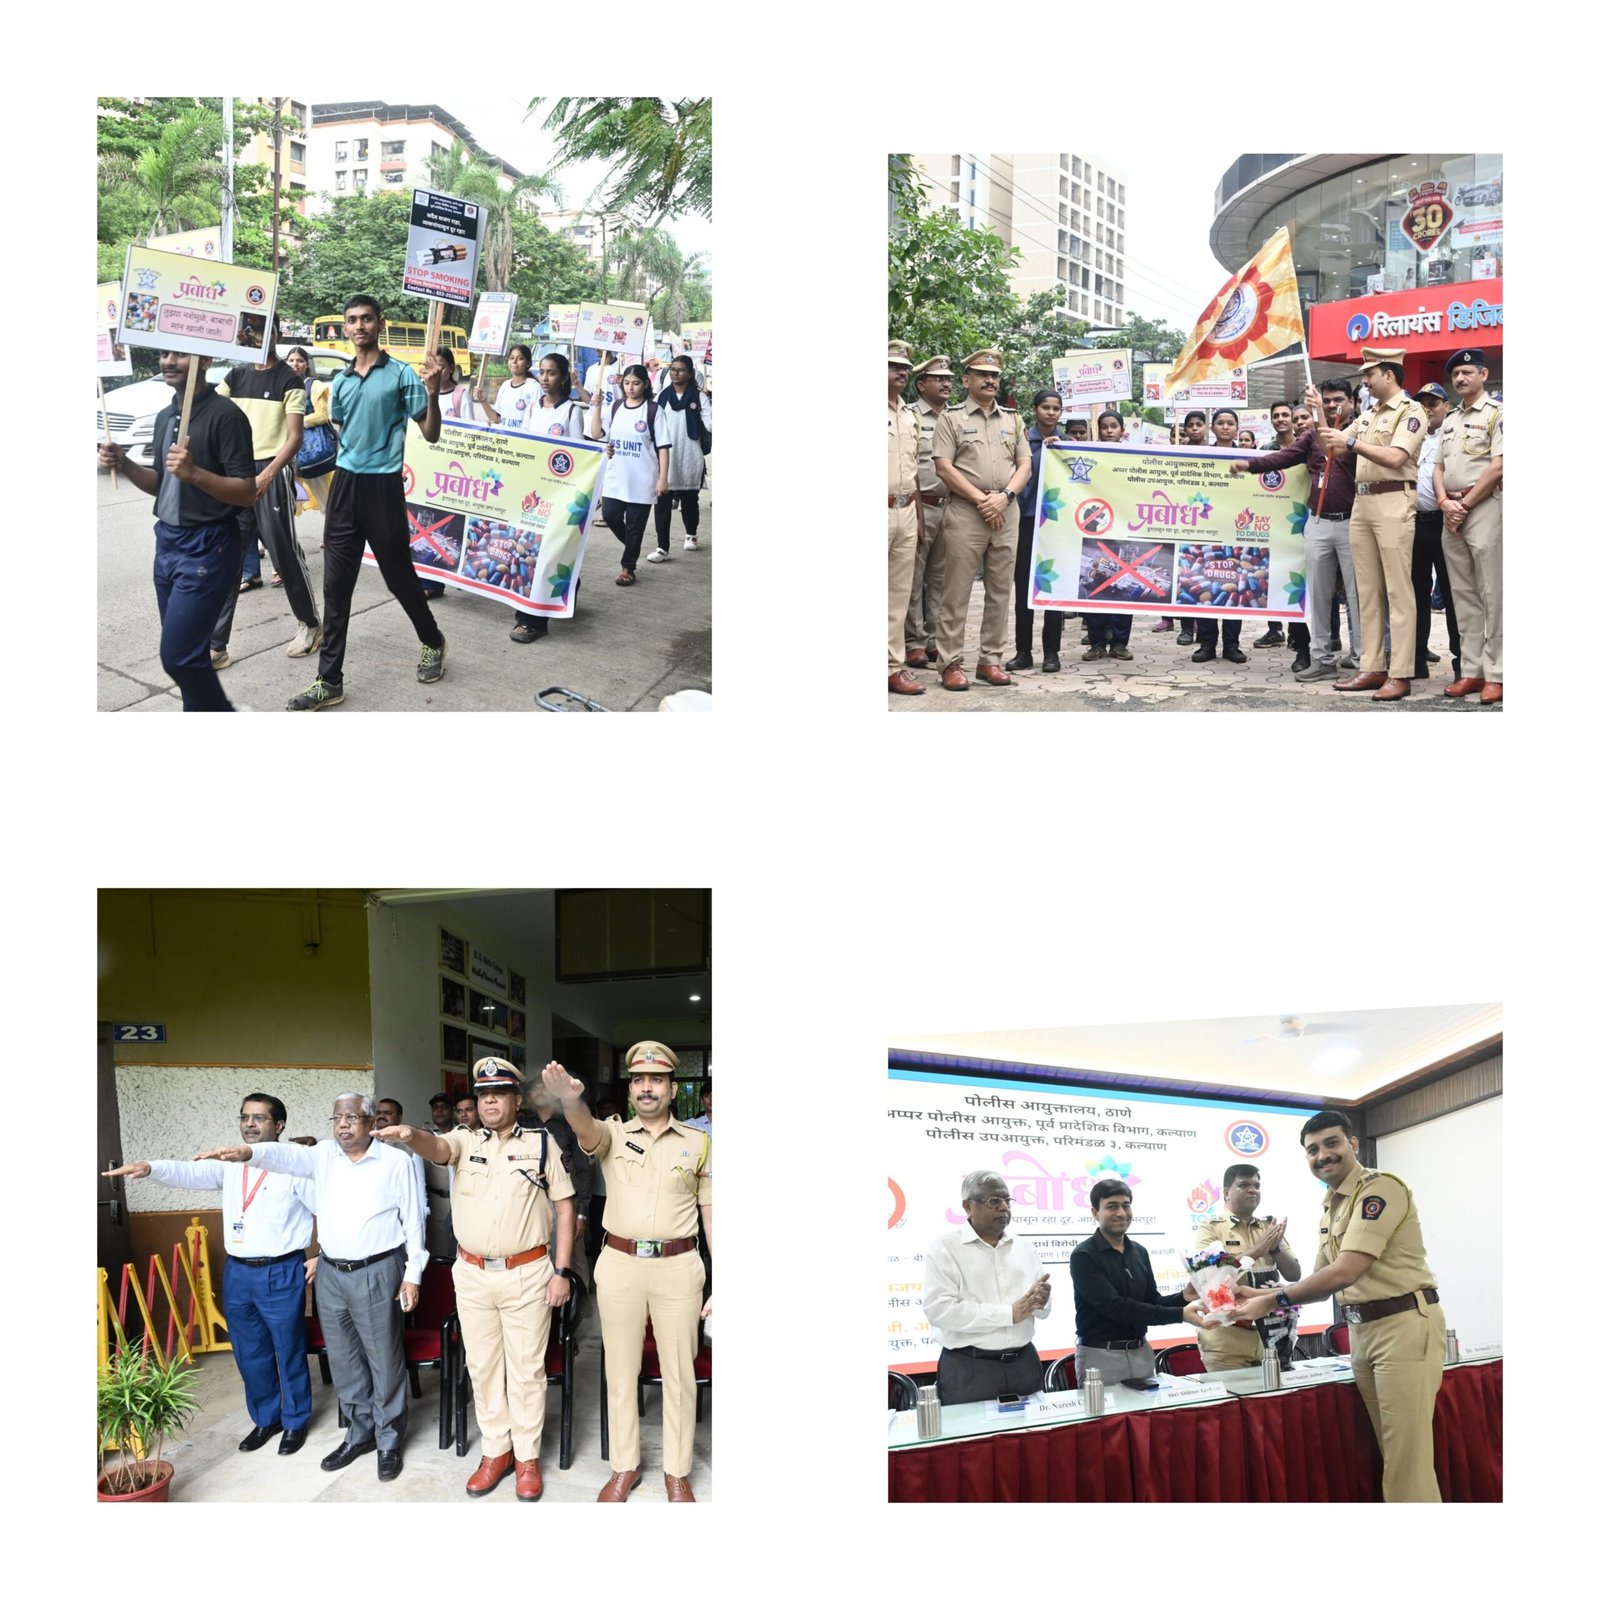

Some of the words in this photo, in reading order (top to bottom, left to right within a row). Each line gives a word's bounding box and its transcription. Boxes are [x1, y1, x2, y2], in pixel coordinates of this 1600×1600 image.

[1411, 204, 1443, 233] 30
[1412, 229, 1441, 241] CRORES
[407, 266, 429, 277] STOP
[430, 271, 470, 287] SMOKING
[407, 284, 426, 293] Contact
[1373, 306, 1443, 339] रिलायंस
[507, 418, 523, 429] UNIT
[623, 440, 642, 452] UNIT
[515, 452, 535, 461] कल्याण
[501, 458, 520, 467] कल्याण
[1142, 458, 1163, 466] पोलीस
[1201, 461, 1215, 469] ठाणे
[426, 461, 491, 501] प्रबोध
[1224, 472, 1245, 480] कल्याण
[540, 500, 553, 508] SAY
[537, 508, 551, 517] NO
[1127, 490, 1200, 531] प्रबोध
[521, 512, 529, 520] TO
[529, 515, 548, 524] DRUGS
[1254, 523, 1270, 531] NO
[494, 538, 513, 550] STOP
[489, 548, 511, 562] DRUGS
[1209, 560, 1234, 569] STOP
[1207, 569, 1237, 579] DRUGS
[120, 1025, 158, 1040] 23
[965, 1094, 1015, 1110] पोलीस
[1020, 1099, 1100, 1118] आयुक्तालय,
[1104, 1106, 1132, 1119] ठाणे
[927, 1109, 976, 1124] पोलीस
[981, 1114, 1032, 1129] आयुक्त,
[1035, 1118, 1055, 1132] पूर्व
[1059, 1119, 1109, 1133] प्रादेशिक
[1113, 1123, 1153, 1137] विभाग,
[1156, 1128, 1198, 1139] कल्याण
[925, 1126, 974, 1141] पोलीस
[979, 1132, 1049, 1147] उपआयुक्त,
[1053, 1135, 1105, 1148] परिमंडळ
[1110, 1140, 1122, 1151] ३,
[1125, 1141, 1167, 1152] कल्याण
[1041, 1215, 1057, 1224] रहा
[1059, 1215, 1074, 1226] दूर,
[1032, 1240, 1049, 1248] दार्थ
[1051, 1239, 1078, 1248] विरोधी
[1052, 1400, 1077, 1409] Naresh
